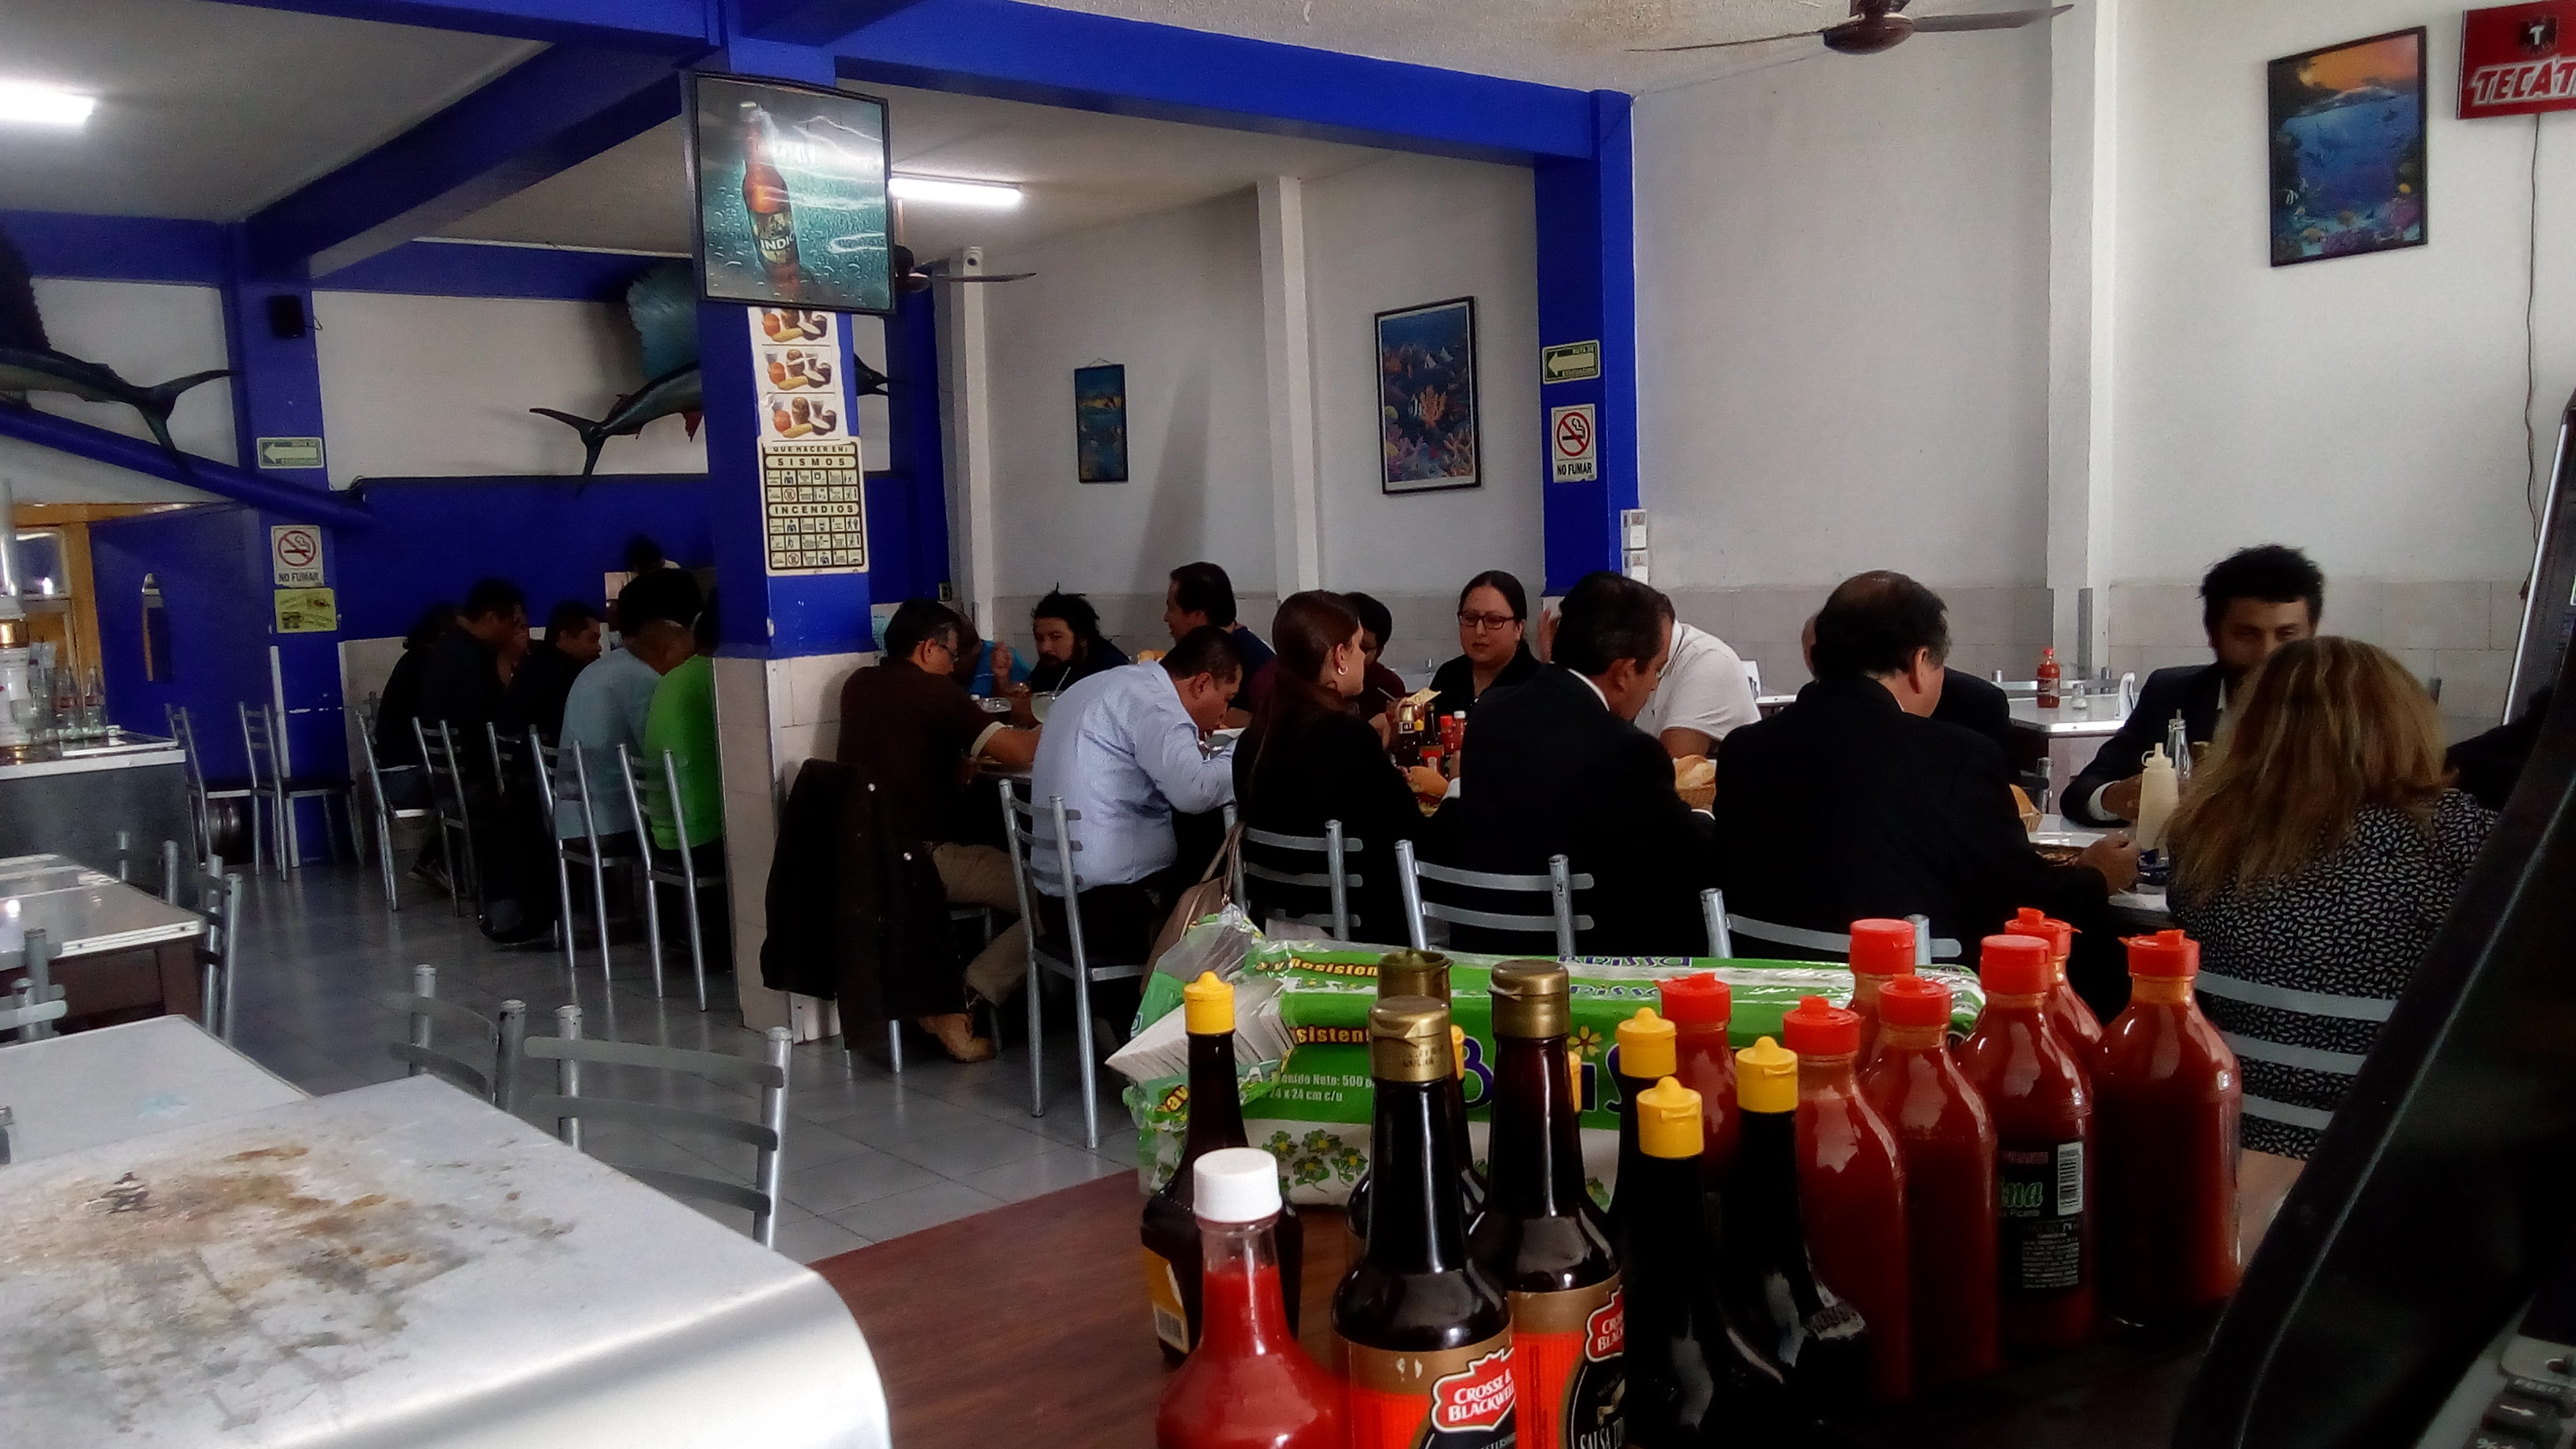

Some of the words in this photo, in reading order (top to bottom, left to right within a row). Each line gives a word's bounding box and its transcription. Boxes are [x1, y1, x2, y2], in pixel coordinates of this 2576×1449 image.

[760, 231, 795, 250] INDIO
[778, 458, 845, 466] SISMOS
[1557, 464, 1567, 476] NO
[1568, 462, 1592, 475] FUMAR
[774, 505, 853, 514] INCENDIOS
[279, 573, 289, 582] NO
[291, 572, 319, 581] FUMAR
[1296, 1027, 1369, 1043] sisten
[1342, 1074, 1363, 1087] 500
[1453, 1374, 1504, 1405] CROSSE
